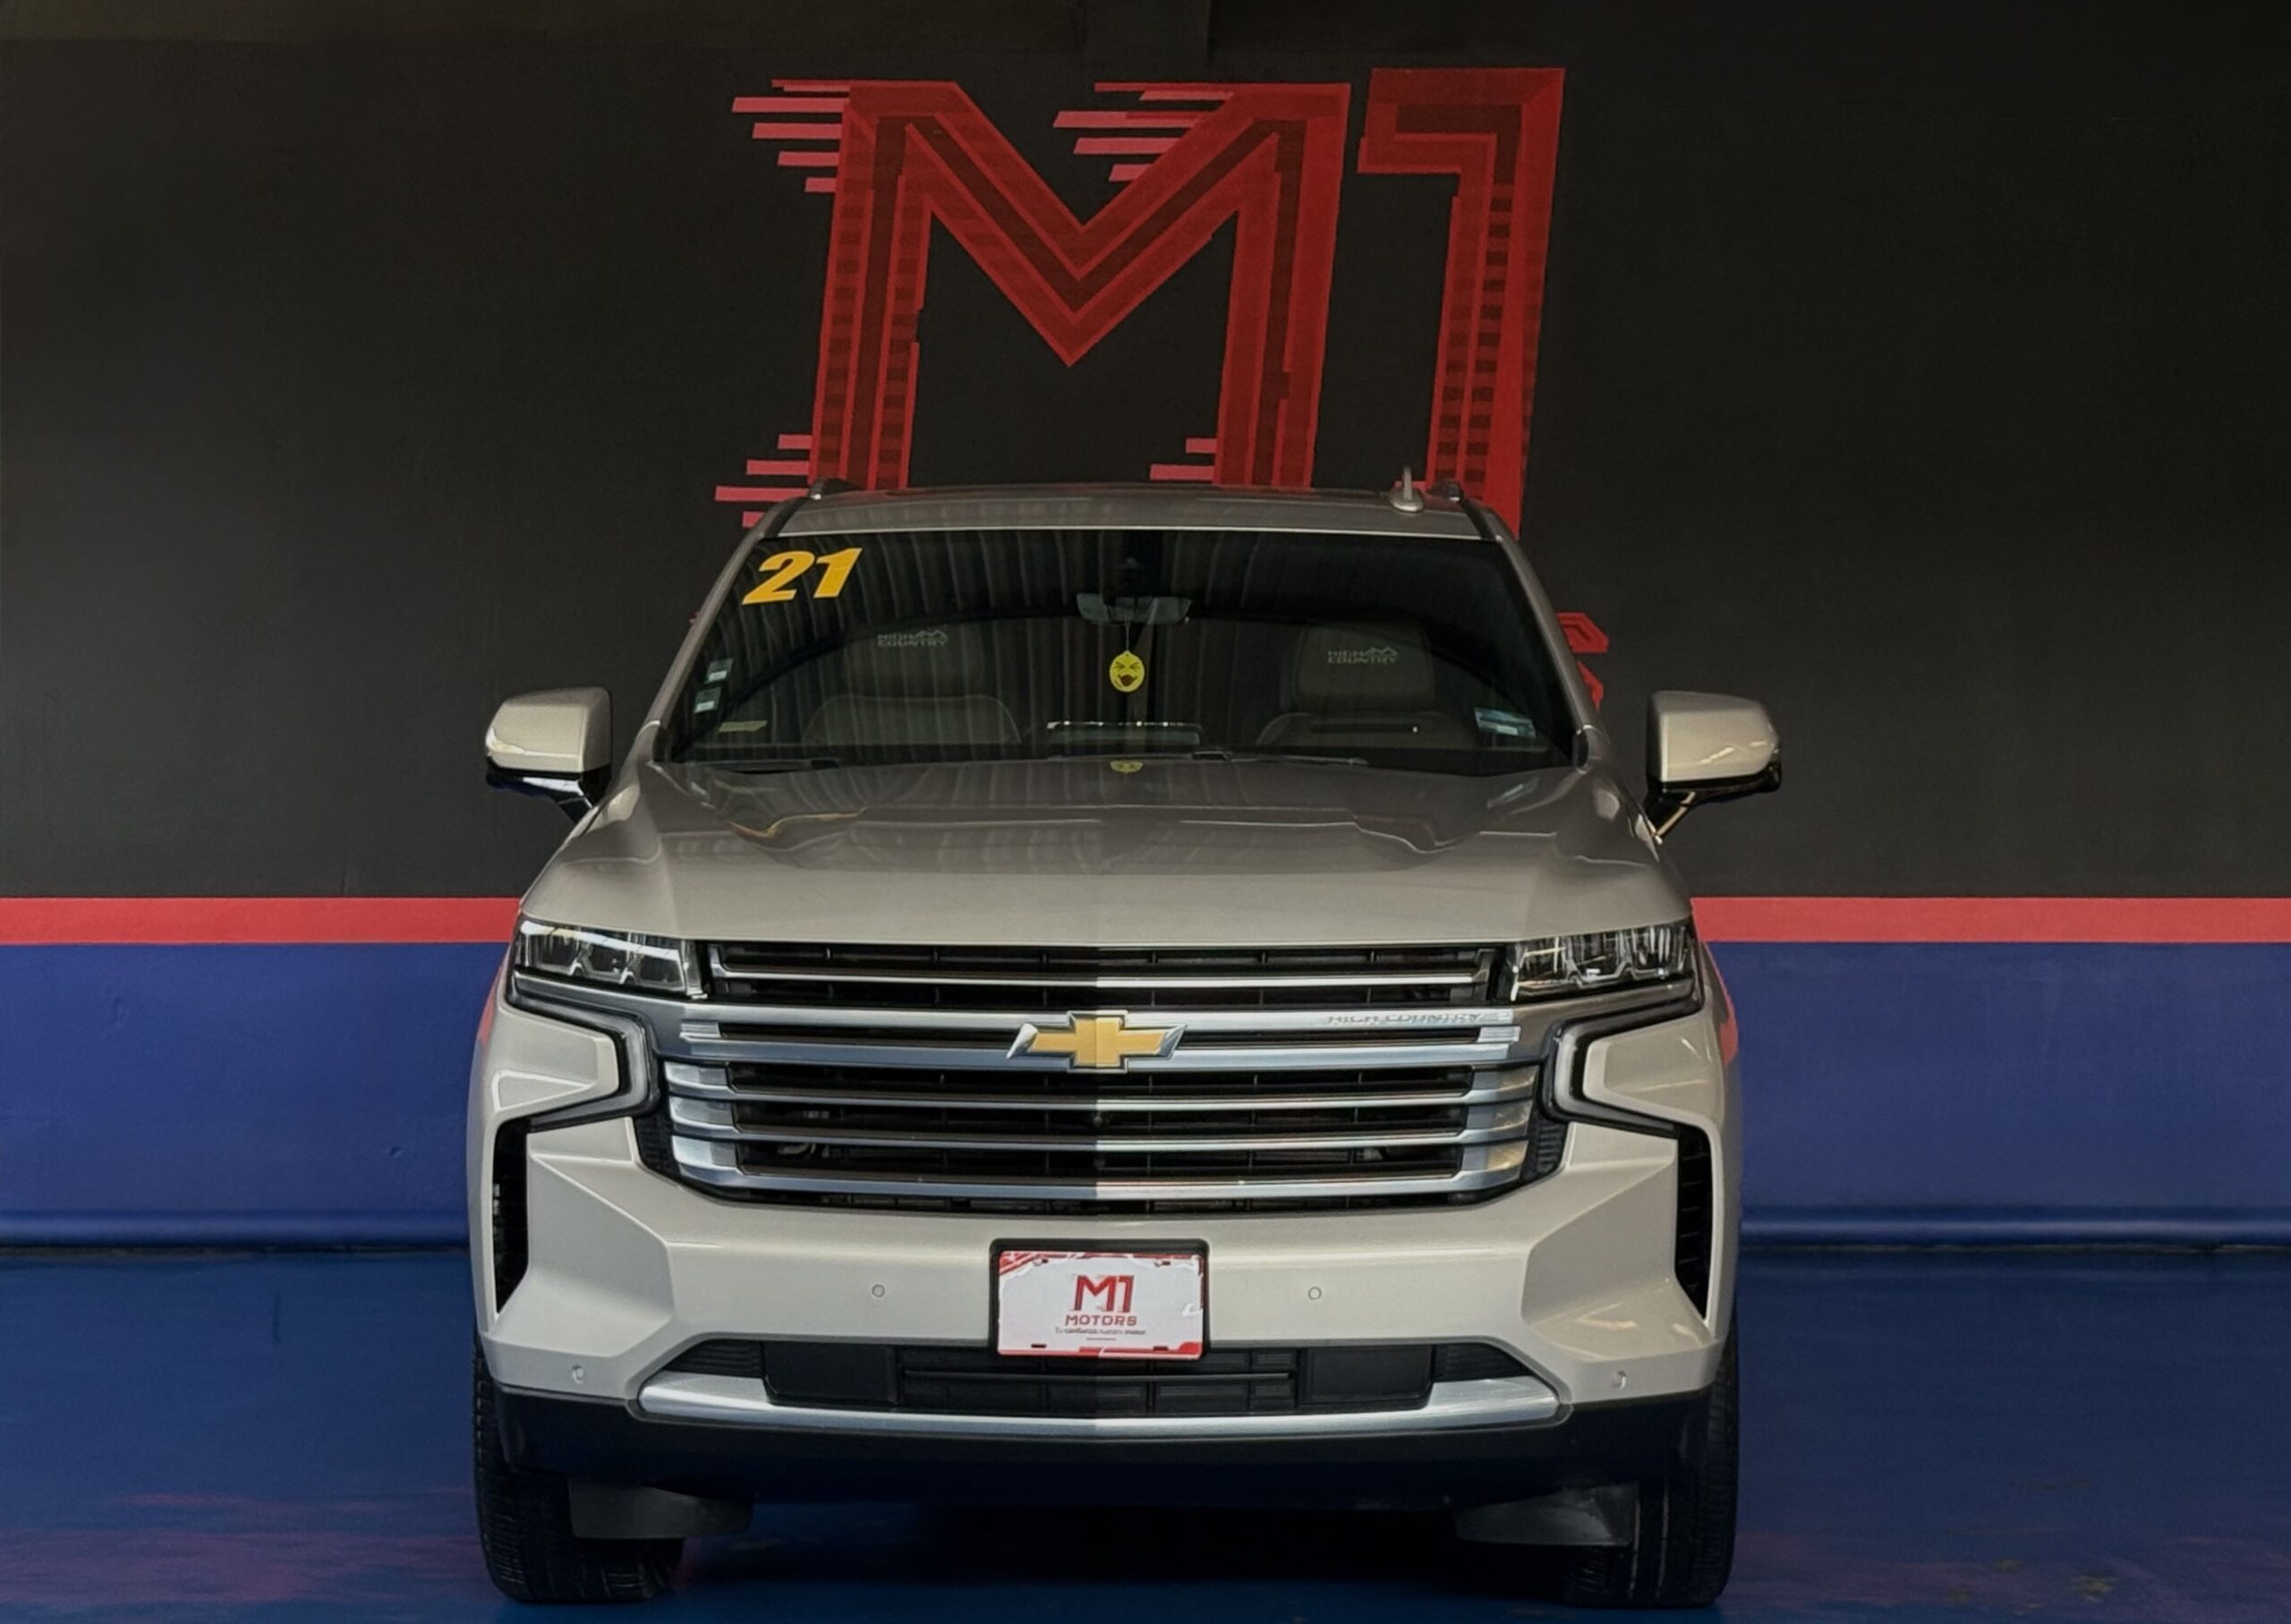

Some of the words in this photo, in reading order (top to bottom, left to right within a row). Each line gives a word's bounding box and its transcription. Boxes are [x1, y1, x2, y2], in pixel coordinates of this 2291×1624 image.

[808, 67, 1565, 538] M1
[742, 548, 863, 605] 21
[1073, 1274, 1134, 1313] M1
[1065, 1314, 1137, 1326] MOTORS
